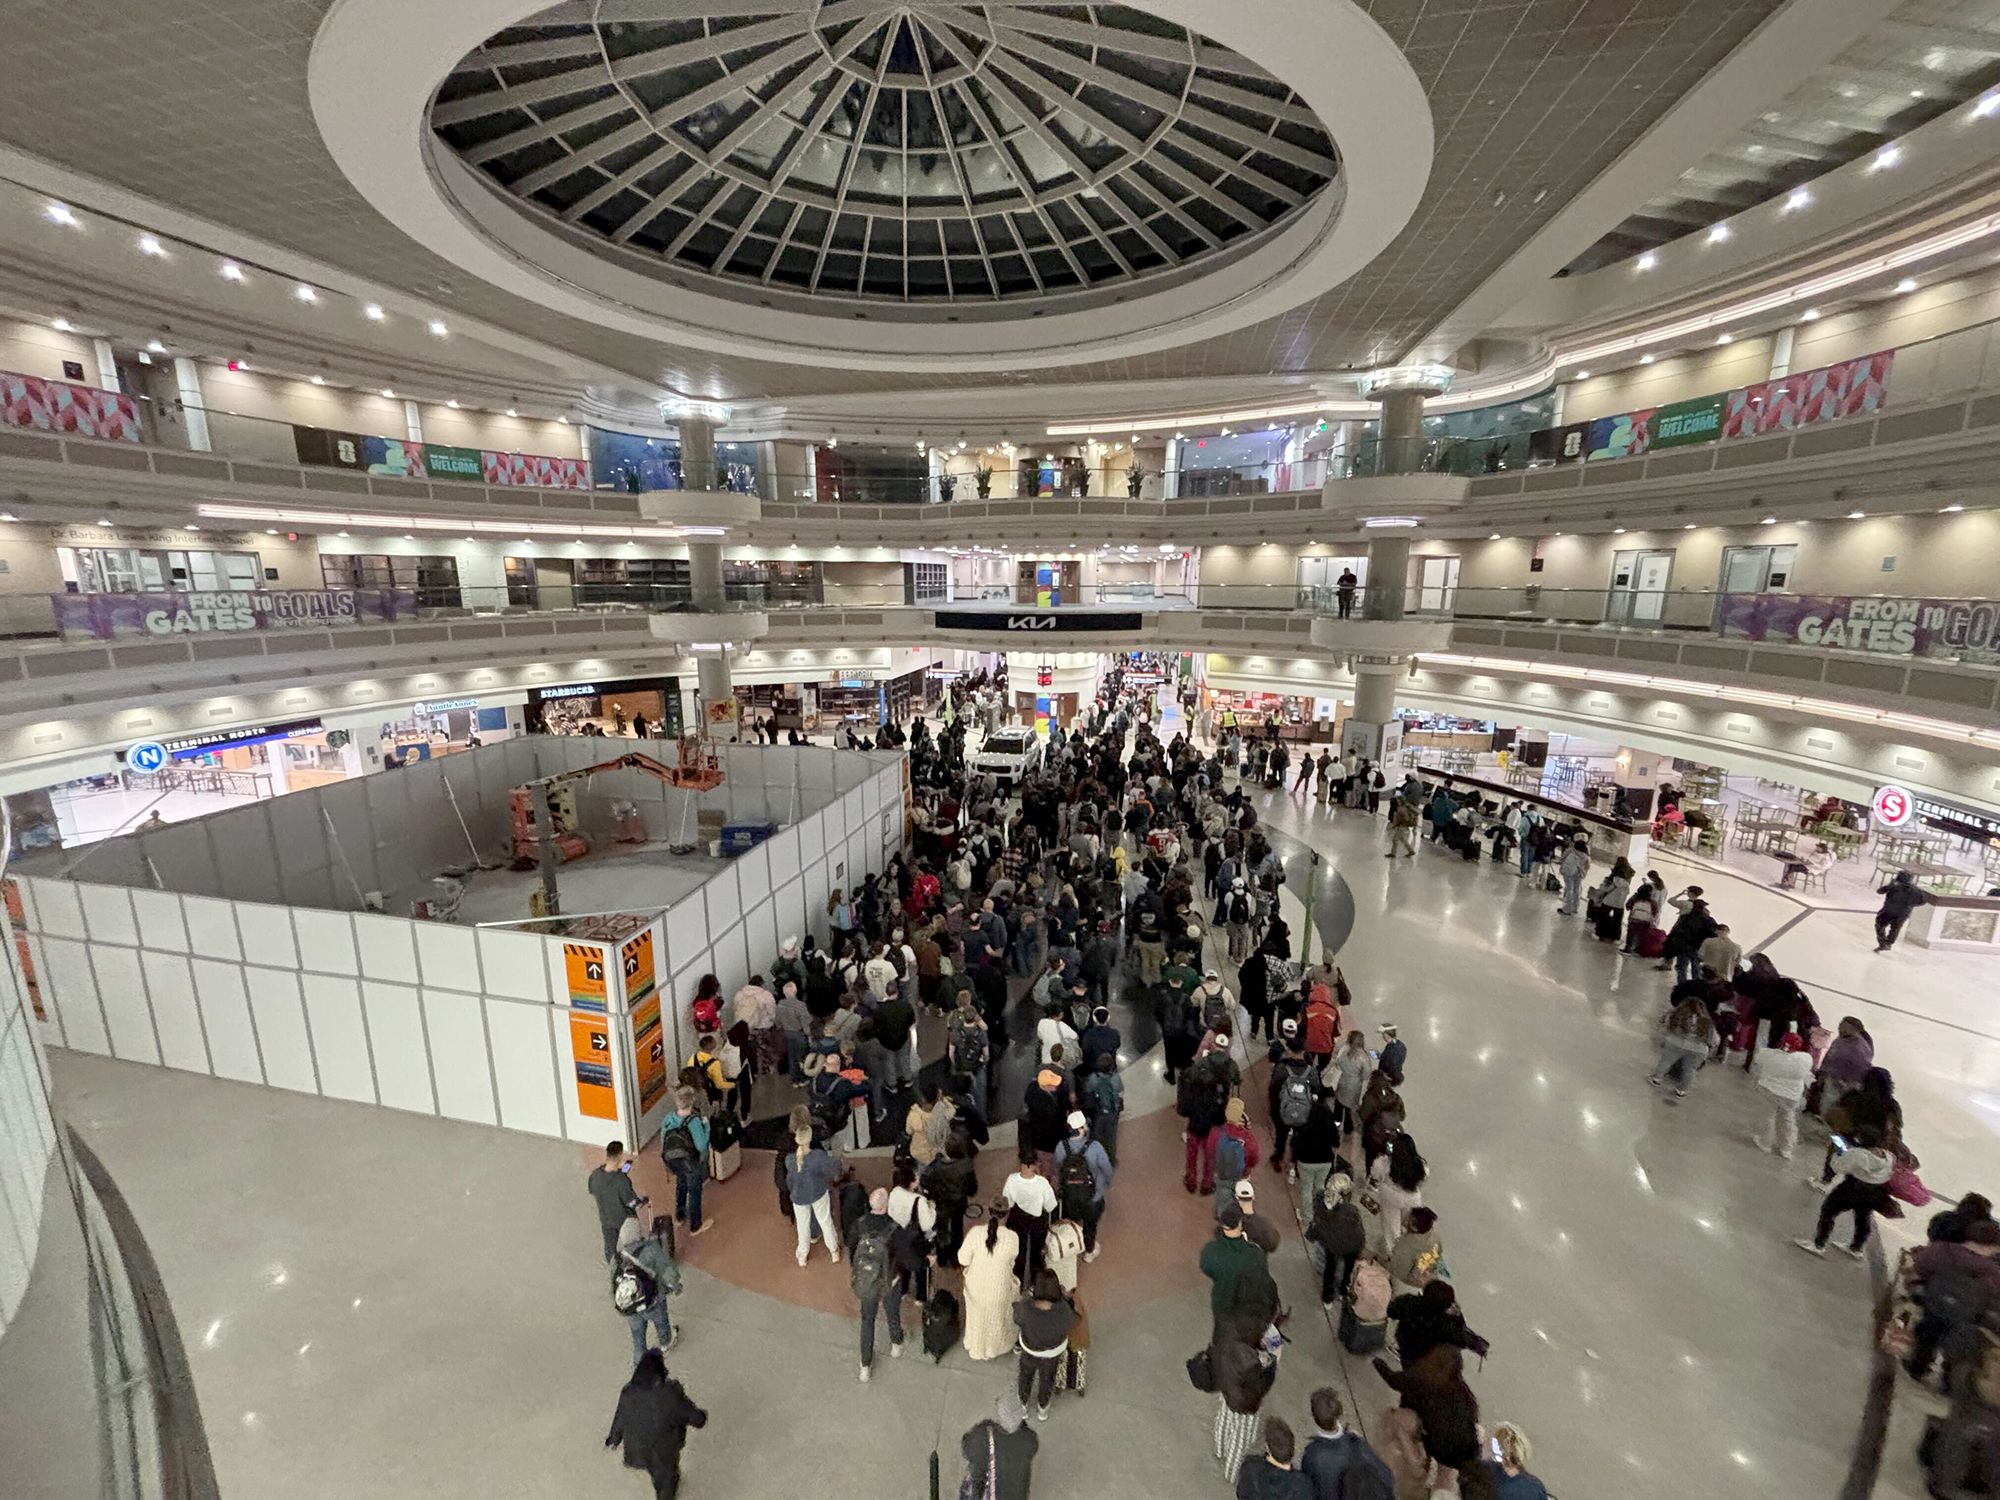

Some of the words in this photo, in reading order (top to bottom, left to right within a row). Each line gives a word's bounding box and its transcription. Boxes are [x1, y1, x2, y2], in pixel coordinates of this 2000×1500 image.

[1658, 414, 1719, 438] WELCOME
[430, 458, 480, 474] WELCOME
[188, 592, 249, 610] FROM
[272, 591, 356, 618] GOALS
[1850, 600, 1920, 622] FROM
[146, 608, 257, 634] GATES
[1798, 616, 1918, 652] GATES
[540, 685, 596, 699] STARBUCKS
[165, 734, 226, 751] TERMINAL
[229, 727, 266, 740] NORTH
[141, 748, 159, 766] N
[1884, 795, 1902, 818] S
[1915, 800, 1983, 828] TERMINAL
